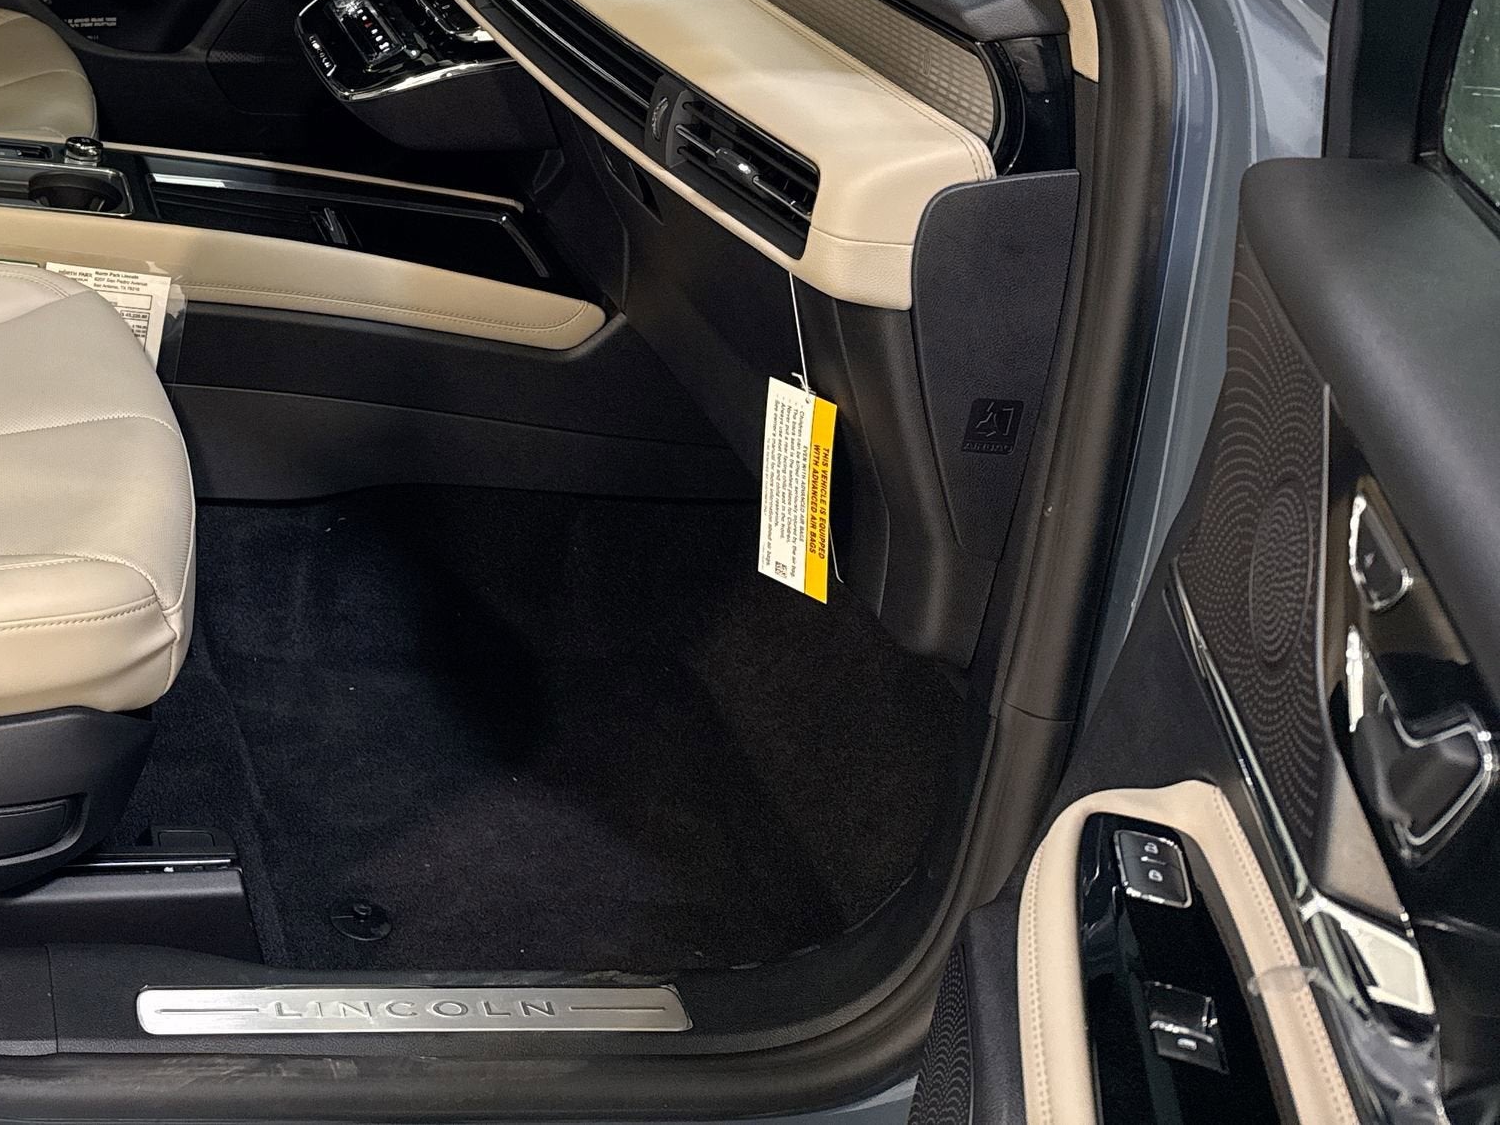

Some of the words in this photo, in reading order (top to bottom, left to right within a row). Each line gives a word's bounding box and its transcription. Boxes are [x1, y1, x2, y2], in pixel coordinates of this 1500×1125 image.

[811, 469, 819, 513] ADVANCED
[820, 470, 828, 504] VEHICLE
[274, 999, 556, 1019] LINCOLN
